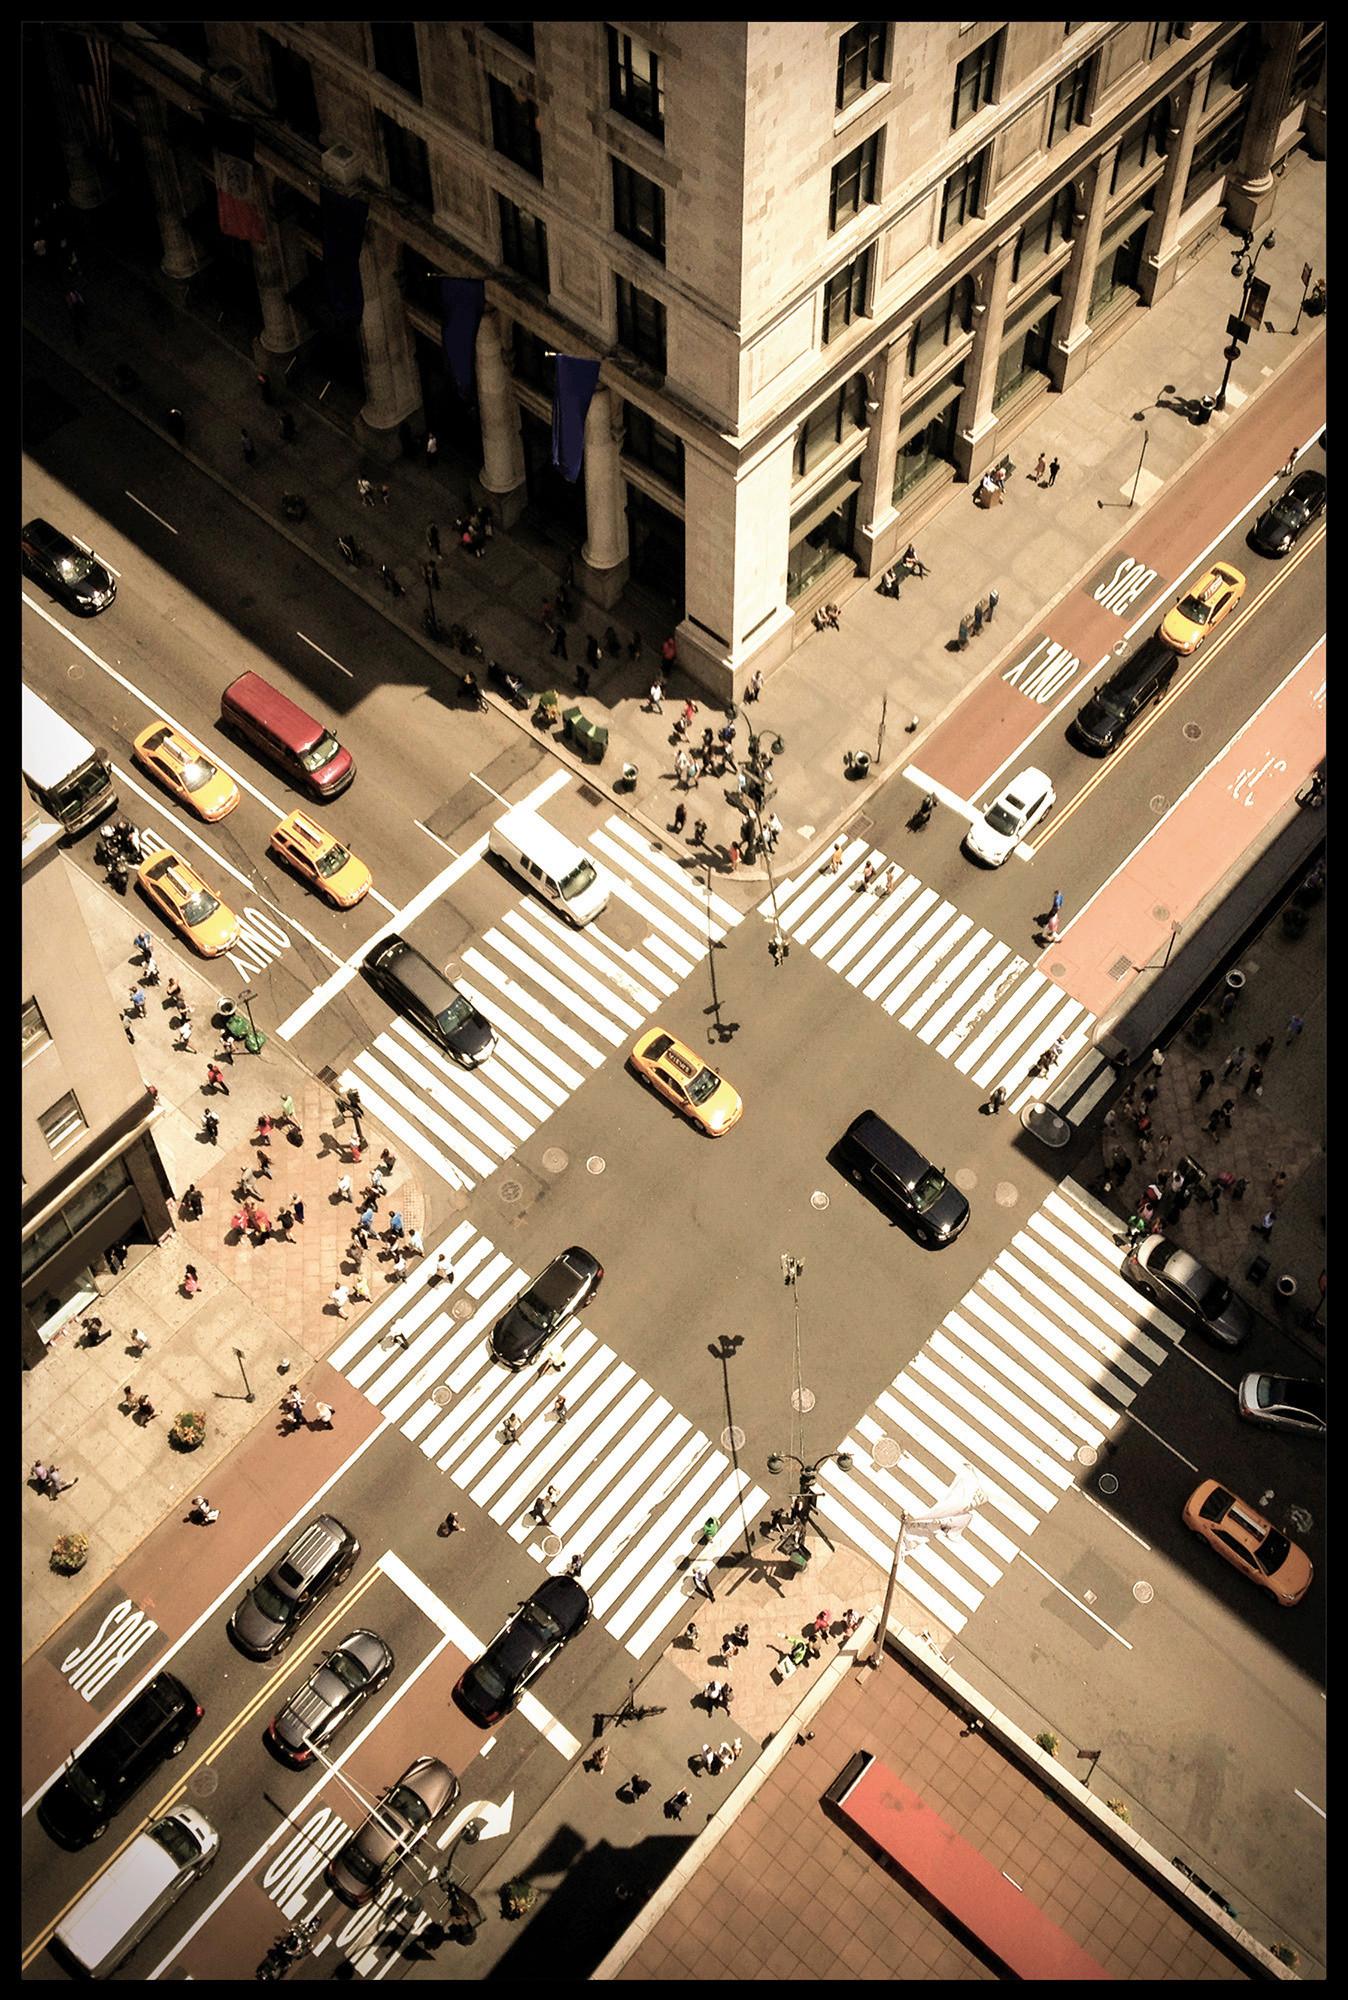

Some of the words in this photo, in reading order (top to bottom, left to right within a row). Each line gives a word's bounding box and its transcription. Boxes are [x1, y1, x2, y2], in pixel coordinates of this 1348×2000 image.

[1093, 557, 1158, 616] BUS
[1002, 636, 1080, 704] ONLY
[61, 1599, 159, 1703] BUS
